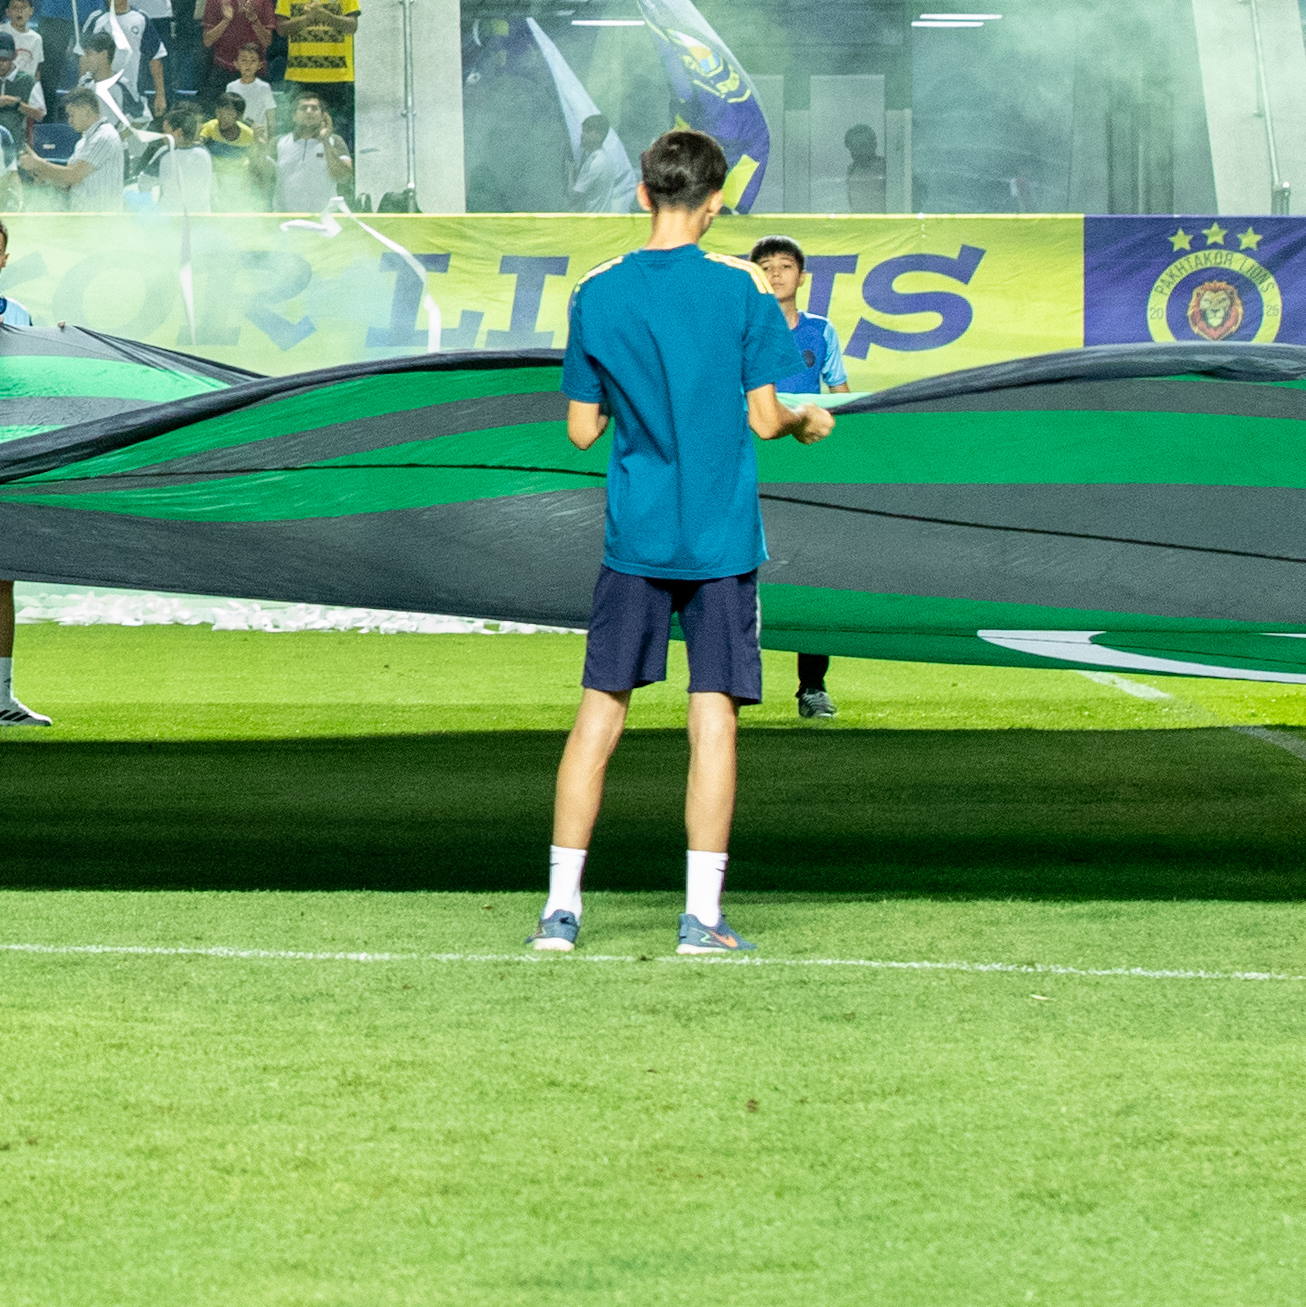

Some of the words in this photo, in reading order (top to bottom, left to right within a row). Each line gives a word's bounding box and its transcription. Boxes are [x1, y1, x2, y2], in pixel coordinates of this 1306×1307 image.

[1154, 250, 1234, 296] PAKHTAKOR
[1238, 258, 1276, 294] LIONS
[365, 243, 987, 360] LIS
[1149, 306, 1164, 320] 20
